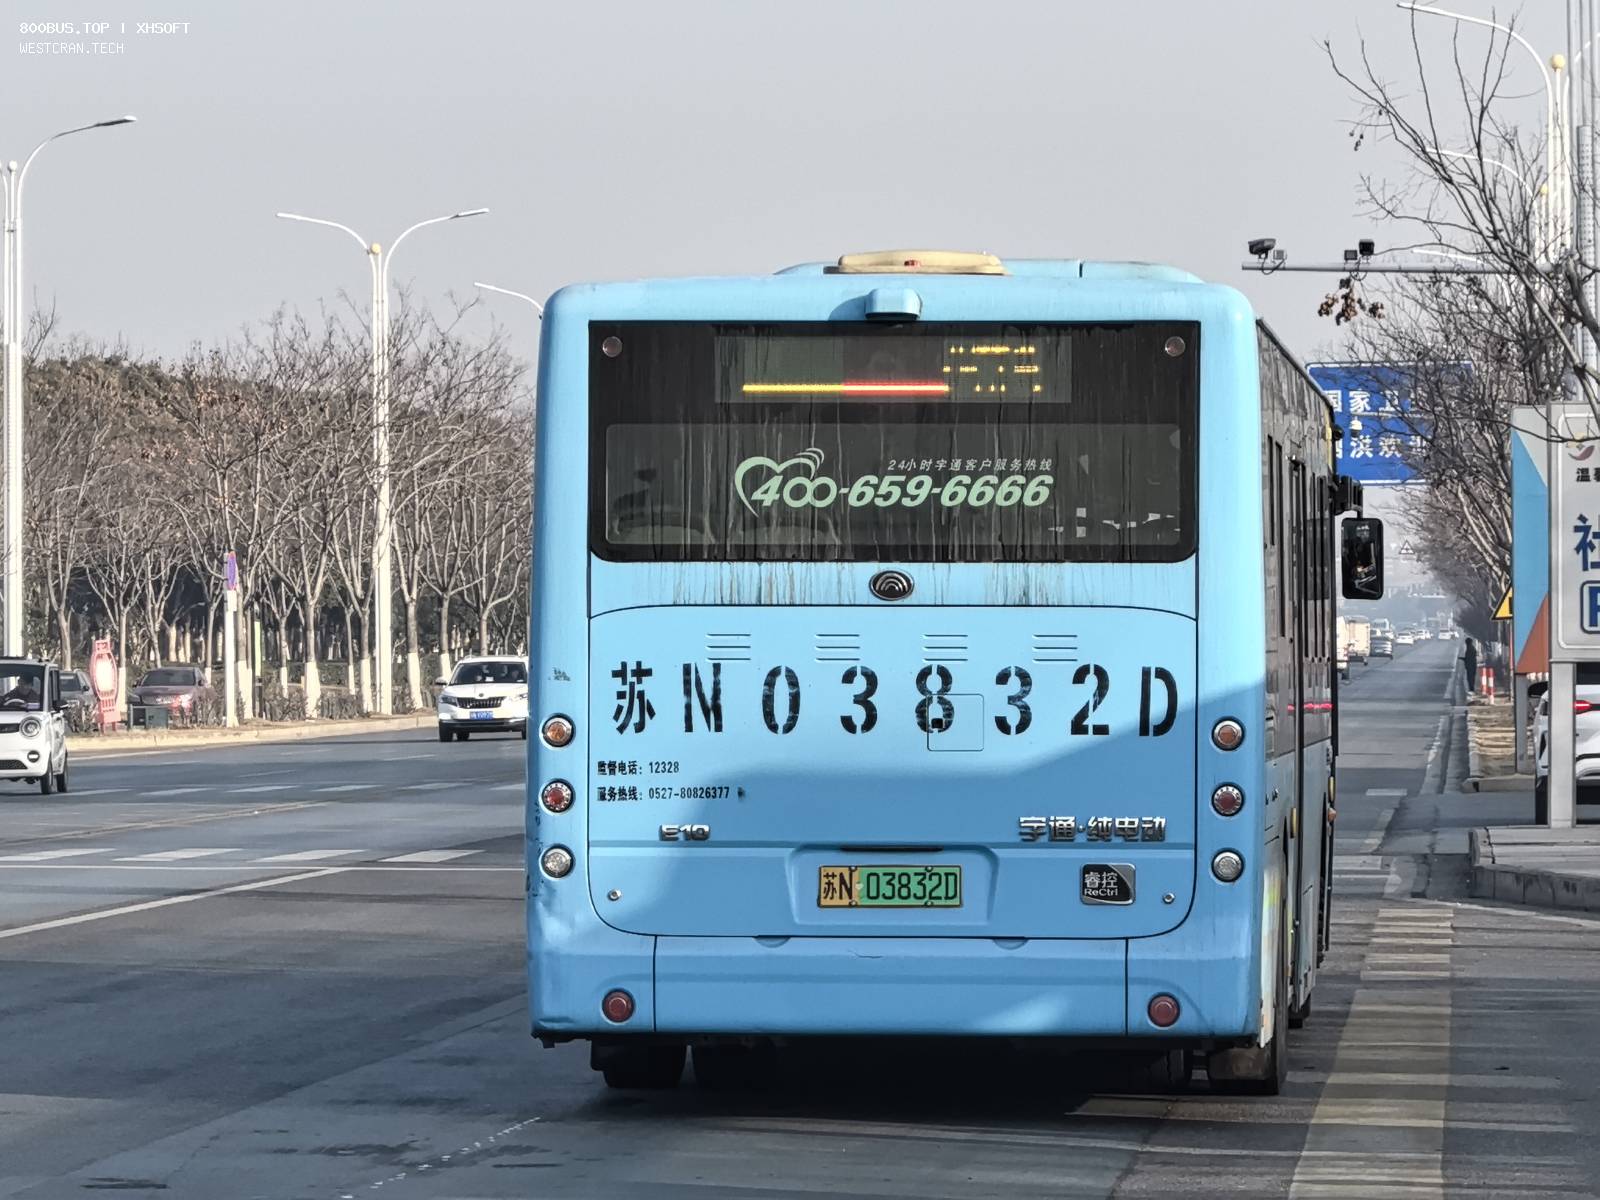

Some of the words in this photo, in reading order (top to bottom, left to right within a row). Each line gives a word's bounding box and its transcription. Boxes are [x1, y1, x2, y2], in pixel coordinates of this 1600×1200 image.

[750, 474, 1055, 508] 400-659-6666
[659, 823, 711, 842] E10
[1084, 871, 1118, 889] 睿控
[1084, 888, 1119, 896] ReCtrl
